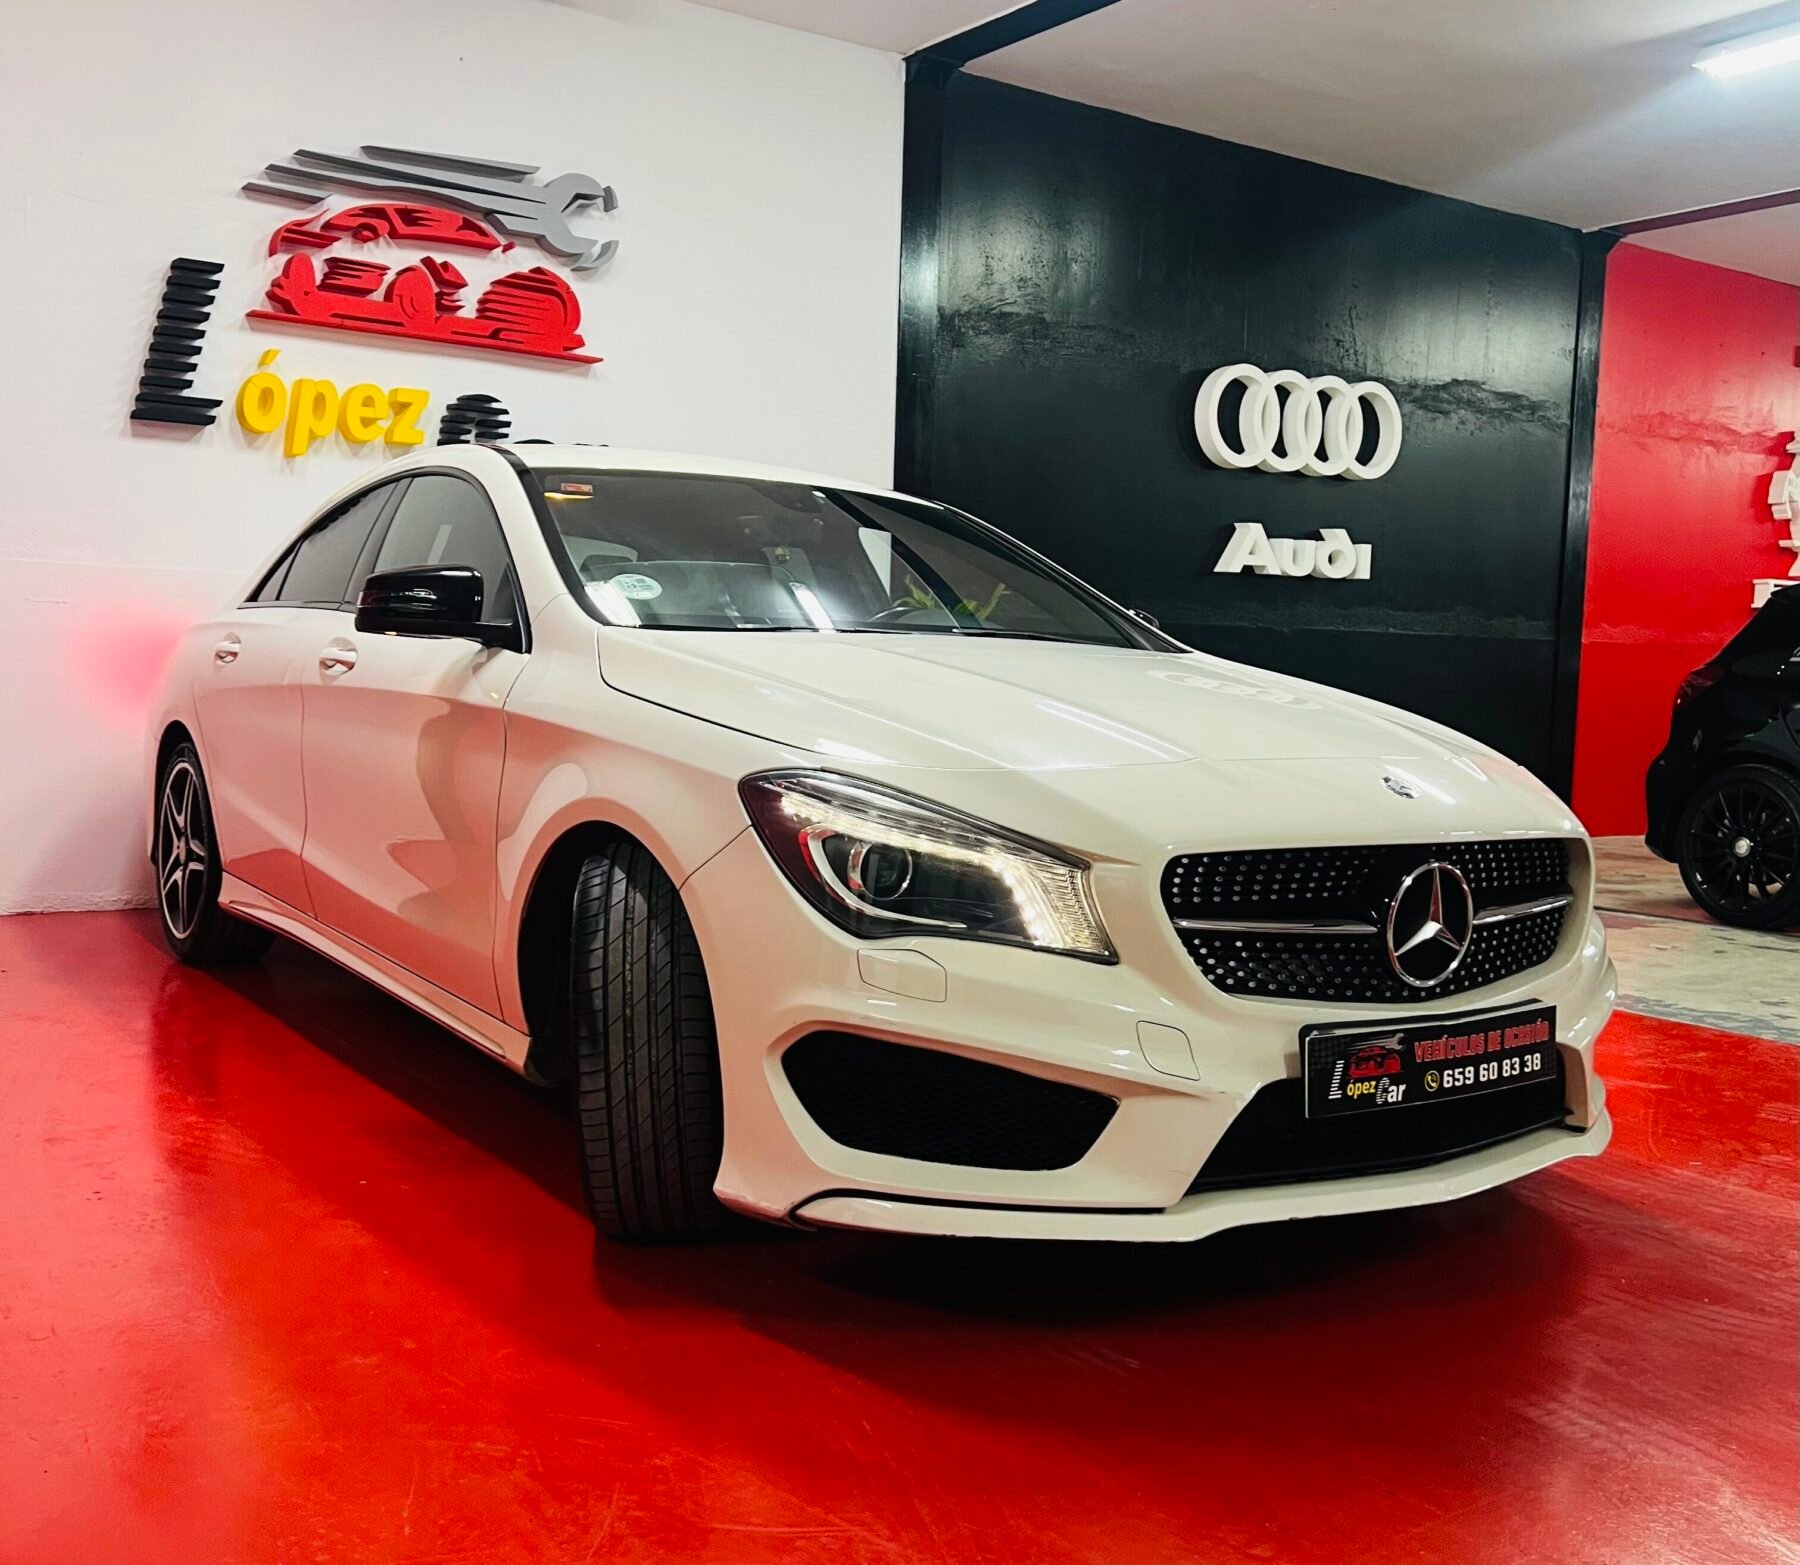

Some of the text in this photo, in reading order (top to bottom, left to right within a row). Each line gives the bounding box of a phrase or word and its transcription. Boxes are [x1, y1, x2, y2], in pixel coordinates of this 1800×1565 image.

[130, 256, 430, 458] López
[1213, 522, 1372, 580] Audi
[1414, 1018, 1550, 1062] VEHÍCULOS DE OCASIÓN
[1328, 1060, 1407, 1105] López Car
[1443, 1052, 1541, 1088] 659 60 83 38
